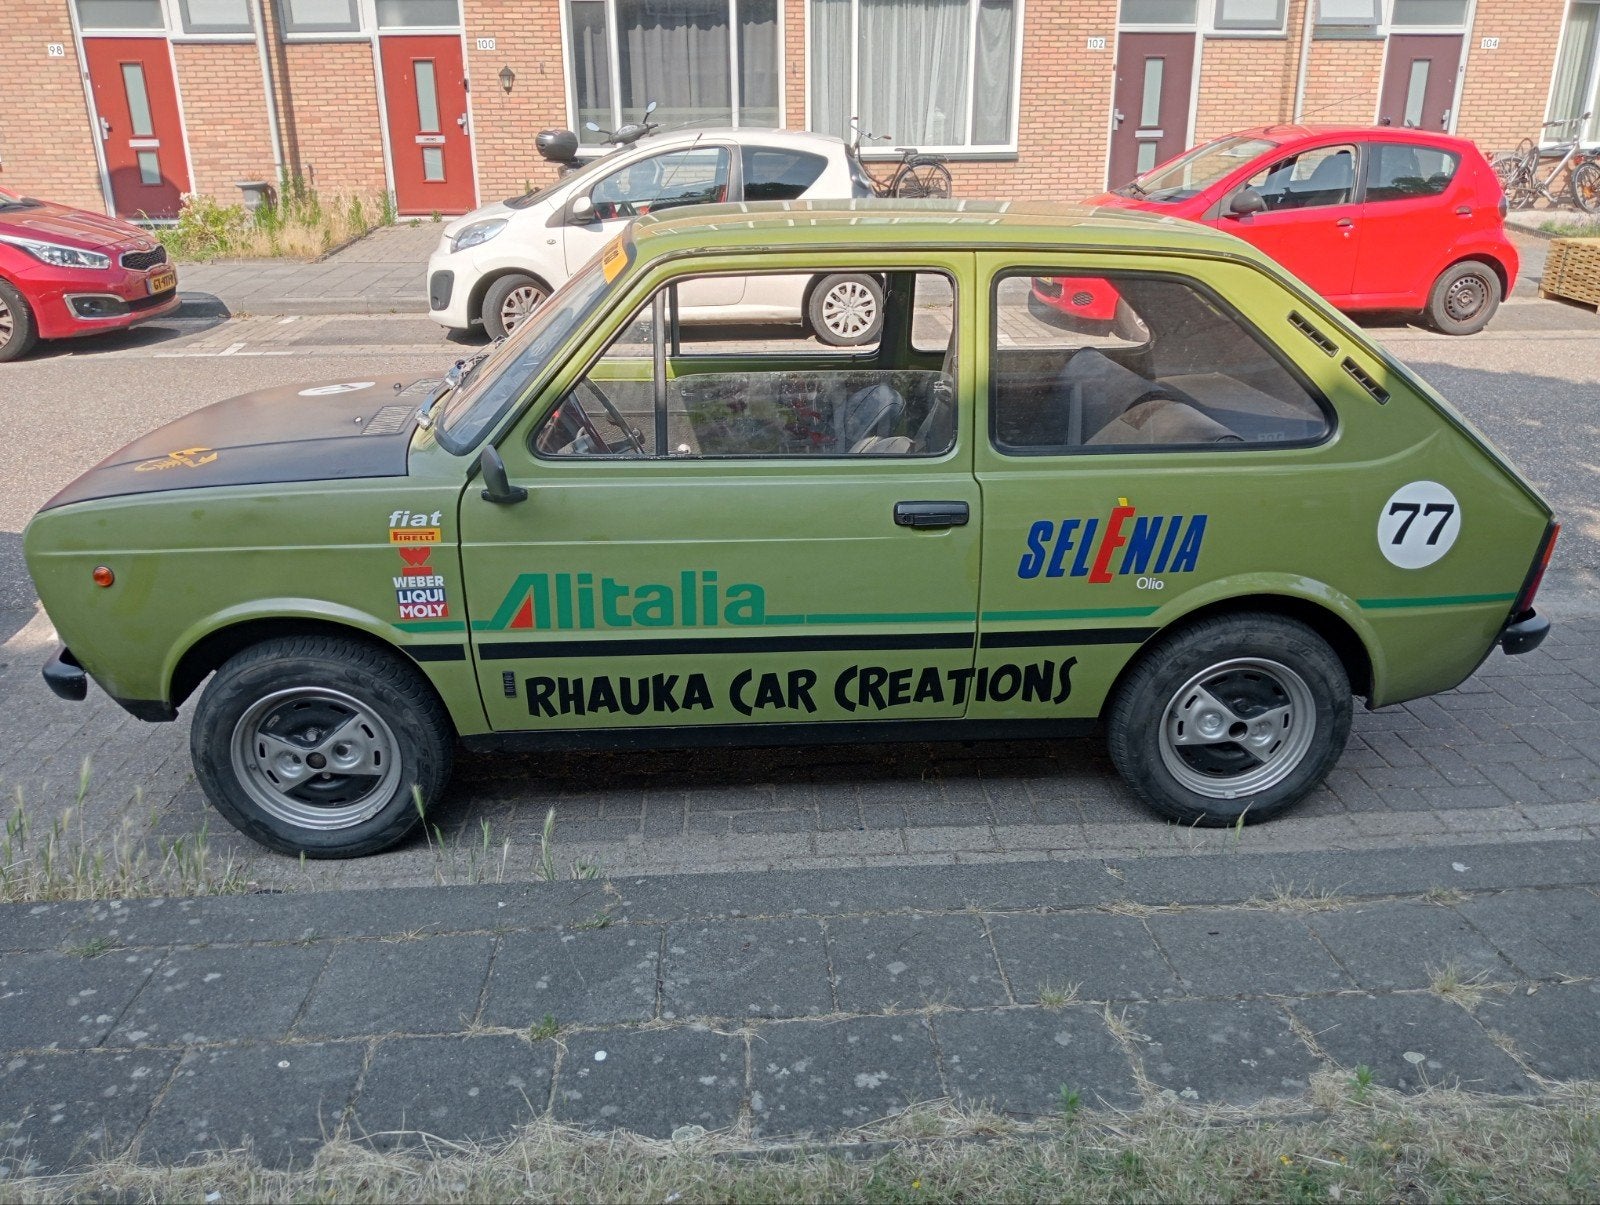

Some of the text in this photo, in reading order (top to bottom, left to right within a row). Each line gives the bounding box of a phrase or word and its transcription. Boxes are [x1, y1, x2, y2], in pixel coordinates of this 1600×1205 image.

[50, 45, 63, 55] 98
[478, 39, 494, 49] 100
[1089, 39, 1104, 49] 102
[1483, 39, 1498, 48] 104
[389, 510, 442, 527] fiat
[1388, 502, 1455, 546] 77
[393, 531, 435, 541] PIRELLI
[393, 576, 445, 588] WEBER
[1136, 577, 1164, 590] Olio
[398, 589, 444, 604] LIQUI
[486, 571, 765, 630] Alitalia
[400, 604, 445, 618] MOLY
[525, 673, 715, 718] RHAUKA
[729, 668, 817, 717] CAR
[834, 656, 1078, 713] CREATIONS
